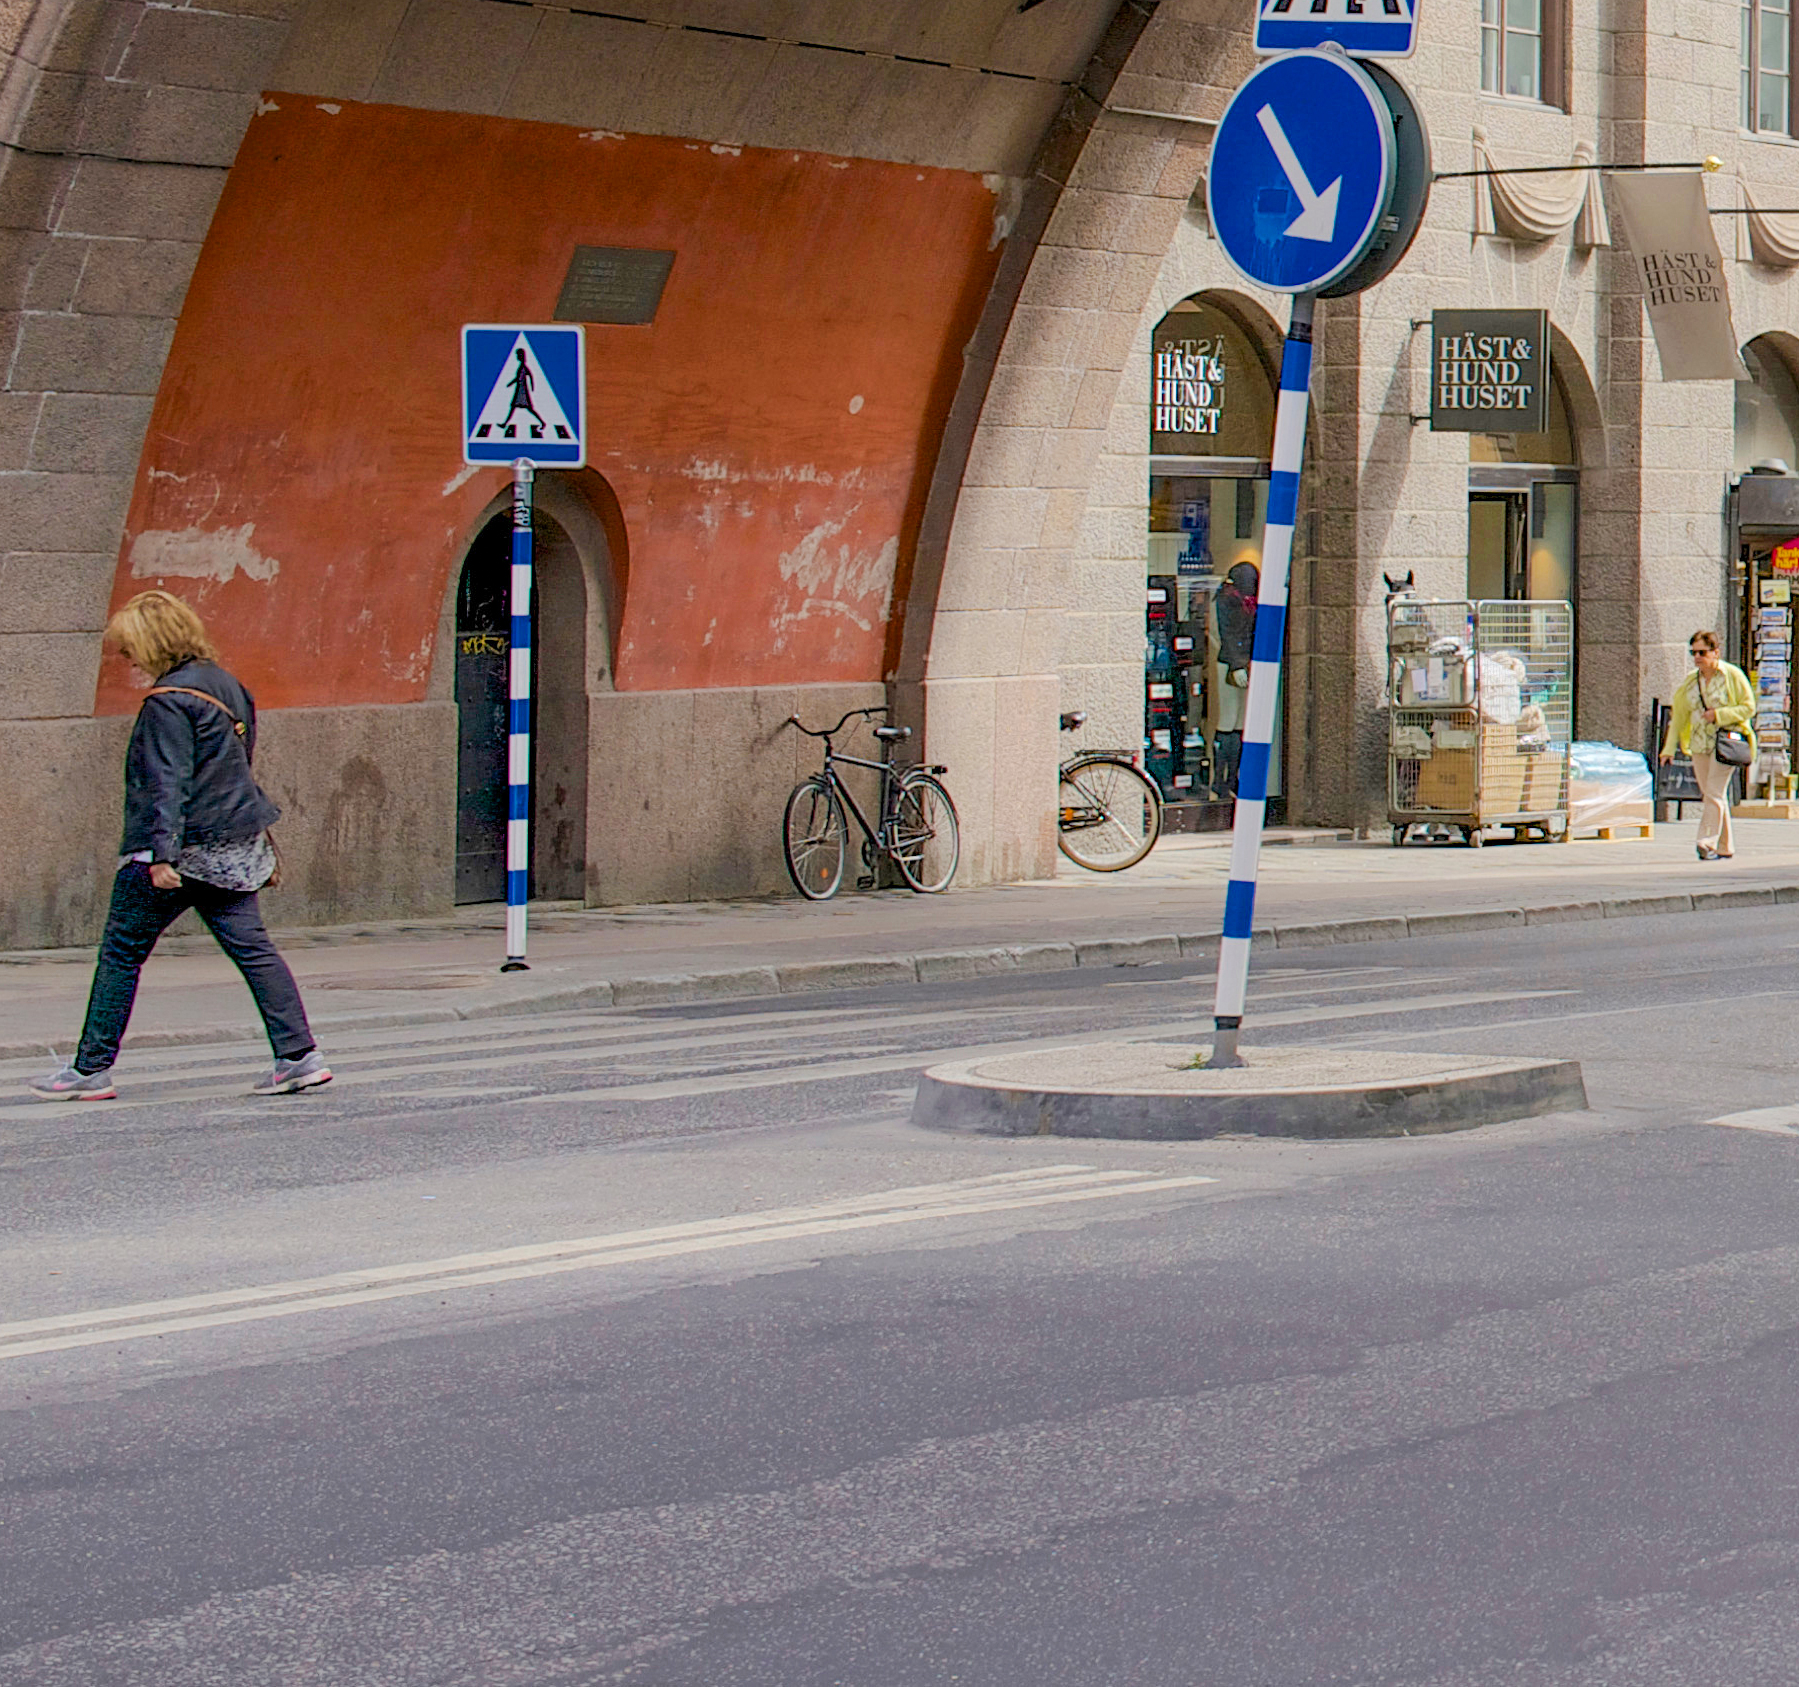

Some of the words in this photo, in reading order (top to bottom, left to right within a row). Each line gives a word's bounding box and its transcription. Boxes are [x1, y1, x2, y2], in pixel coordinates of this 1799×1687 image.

[1643, 249, 1699, 272] HÄST
[1704, 254, 1718, 270] &
[1646, 269, 1712, 290] HUND
[1650, 286, 1720, 307] HUSET
[1439, 361, 1521, 385] HUND
[1156, 379, 1214, 407] HUND
[1438, 384, 1533, 410] HUSET
[1154, 405, 1222, 433] HUSET
